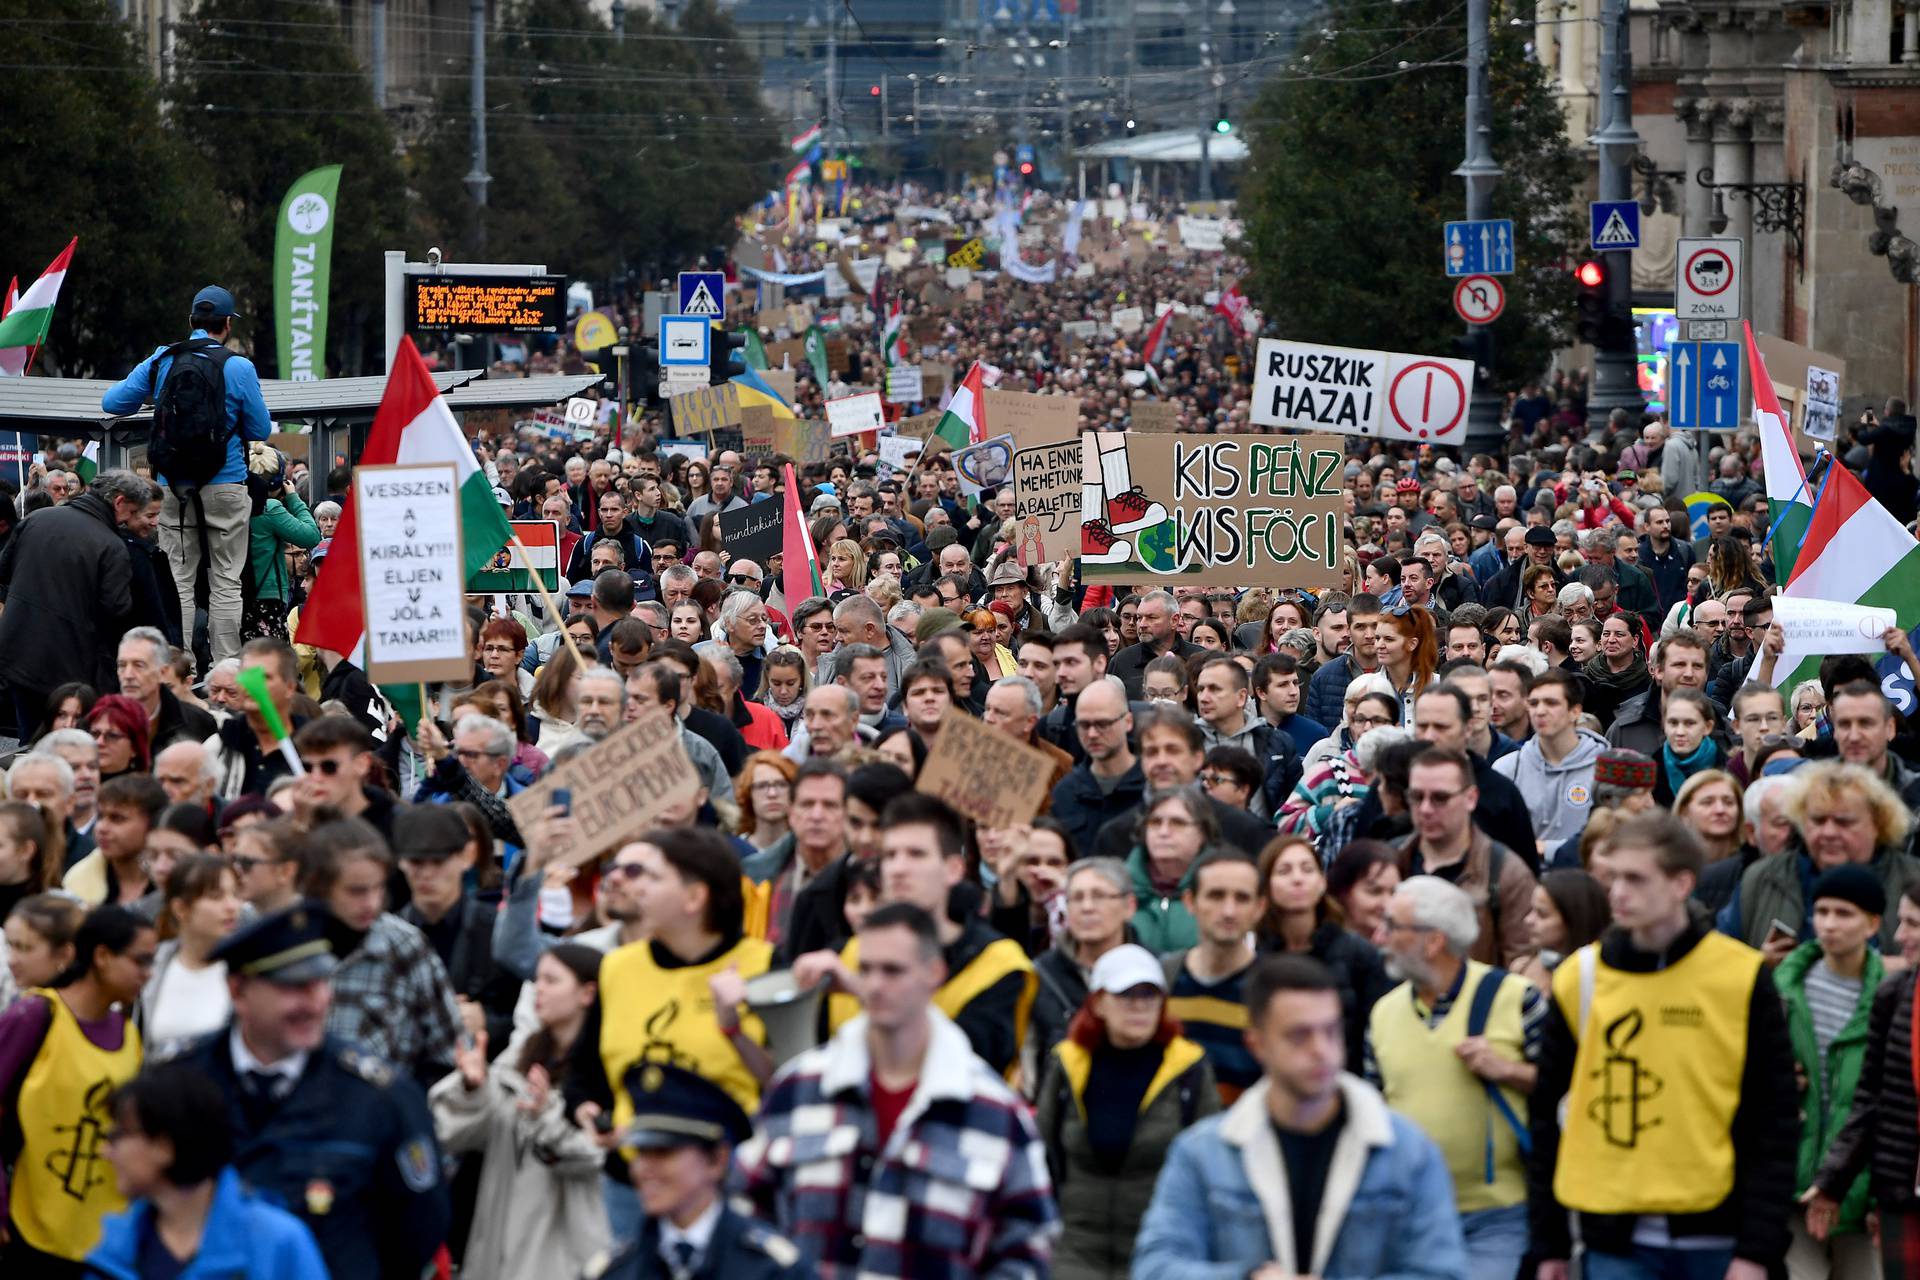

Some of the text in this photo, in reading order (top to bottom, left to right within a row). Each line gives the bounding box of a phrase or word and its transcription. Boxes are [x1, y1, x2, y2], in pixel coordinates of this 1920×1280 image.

[418, 285, 555, 296] Forgalmi változás rendezvény miatt!
[455, 293, 474, 302] pesti
[477, 293, 505, 302] oldalon
[291, 242, 319, 381] TANÍTANÉ
[447, 300, 470, 308] Kálvin
[1691, 302, 1725, 313] ZÓNA
[1268, 351, 1374, 387] RUSZKIK
[1271, 385, 1372, 434] HAZA!
[1021, 447, 1082, 471] HA ENNE
[1174, 438, 1343, 500] KIS PÉNZ
[365, 481, 450, 498] VESSZEN
[1028, 491, 1082, 514] BALETTB
[403, 508, 416, 521] A
[725, 507, 783, 543] mindenkiért
[1174, 505, 1243, 568] KIS
[384, 567, 442, 585] ÉLJEN
[389, 604, 442, 621] JÓL A
[377, 627, 458, 646] TANÁR!!!
